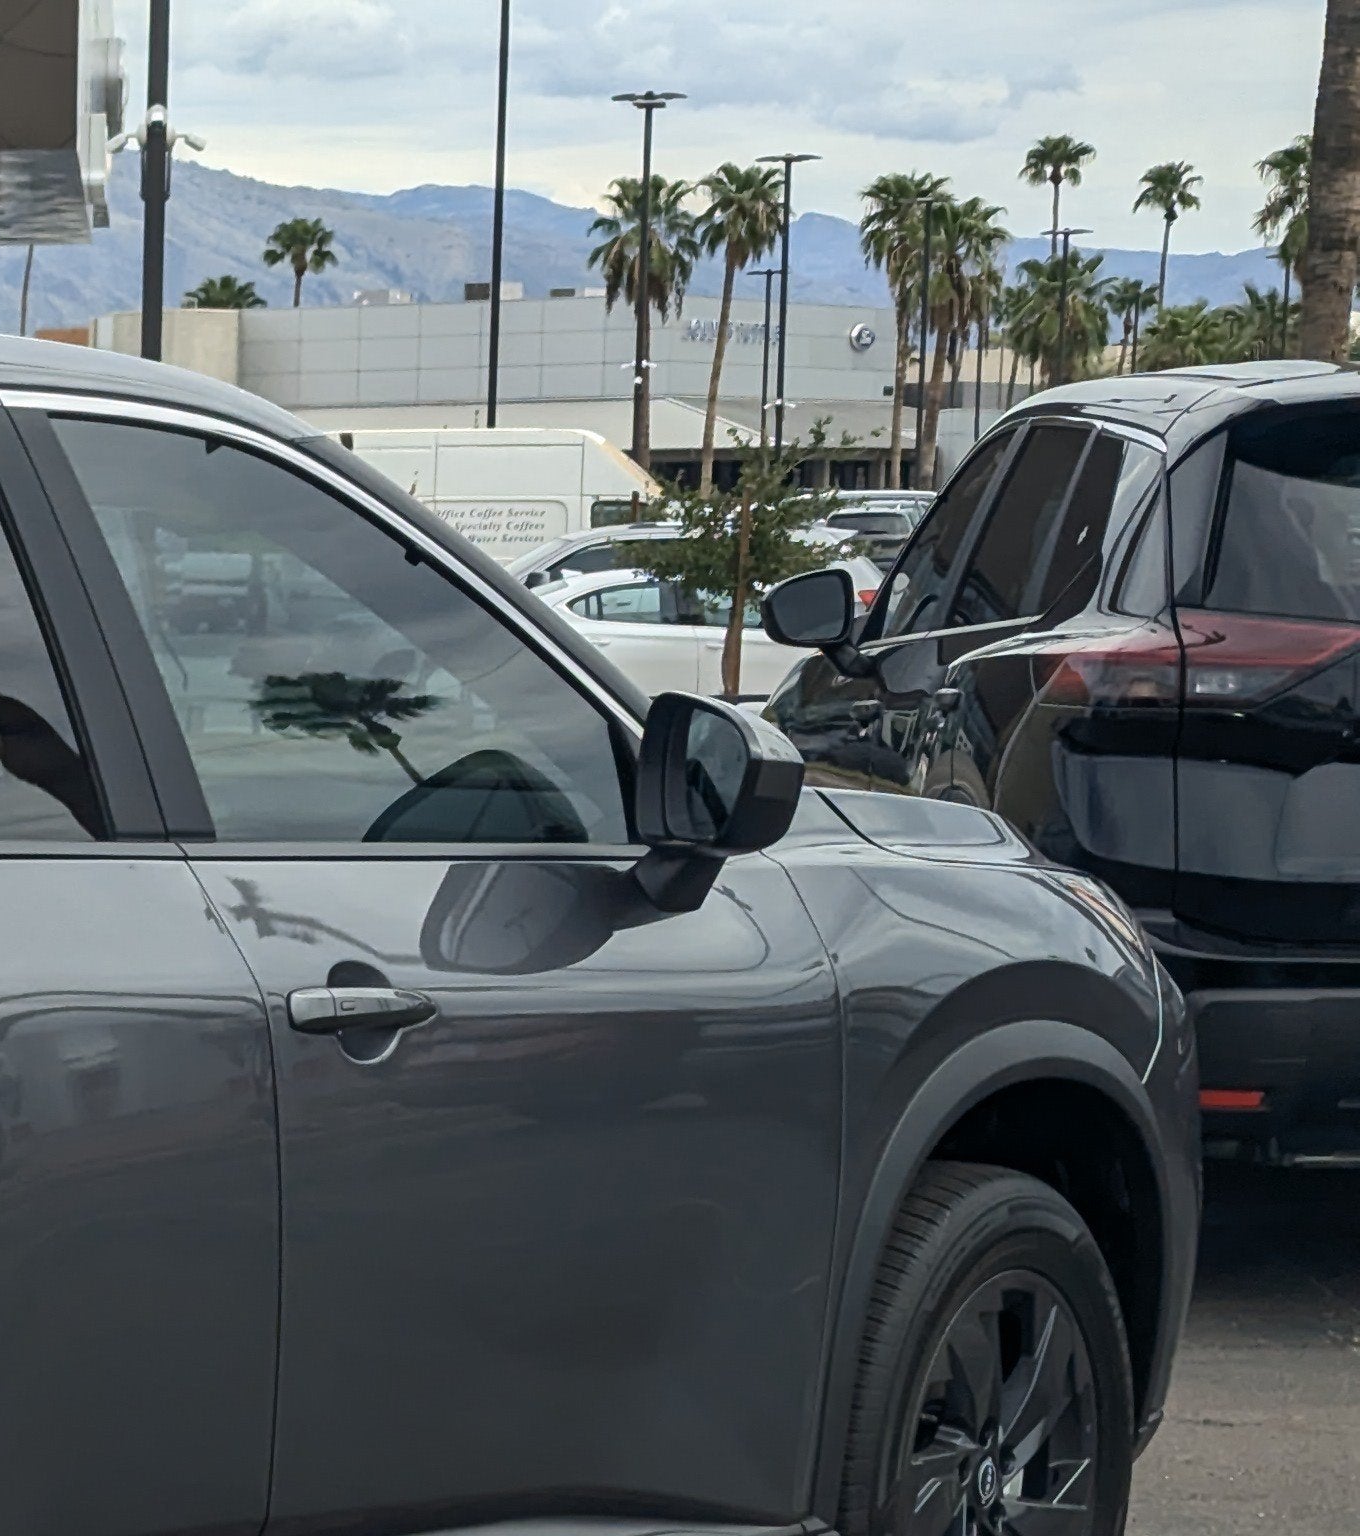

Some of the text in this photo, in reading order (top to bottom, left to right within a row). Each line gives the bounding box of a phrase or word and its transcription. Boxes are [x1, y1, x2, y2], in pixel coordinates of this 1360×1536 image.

[470, 508, 503, 519] Coffee
[507, 508, 546, 517] Service
[506, 521, 544, 531] Coffees
